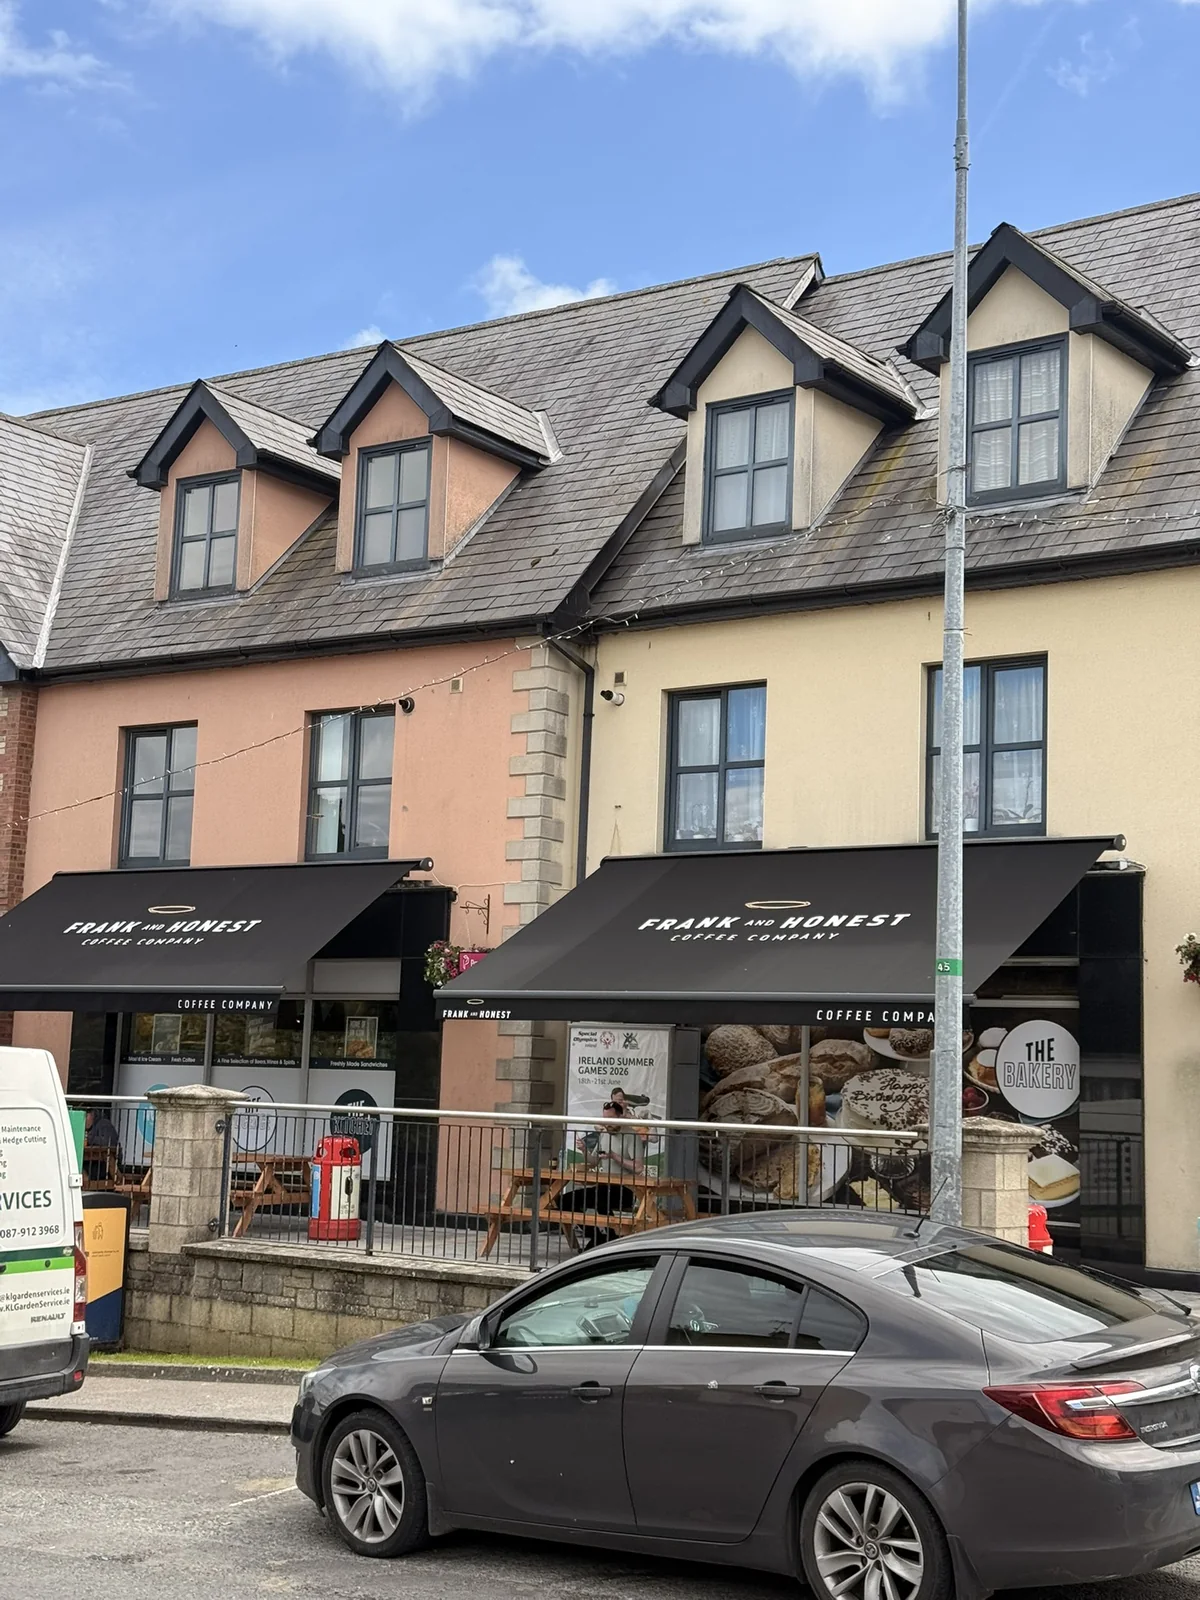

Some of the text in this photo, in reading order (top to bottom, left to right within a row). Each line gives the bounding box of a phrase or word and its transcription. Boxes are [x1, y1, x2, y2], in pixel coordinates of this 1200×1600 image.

[63, 921, 142, 934] FRANK
[165, 920, 262, 933] HONEST
[638, 913, 911, 931] FRANK AND HONEST
[81, 937, 204, 946] COFFEE COMPANY
[670, 932, 840, 942] COFFEE COMPANY
[937, 961, 951, 972] 45
[177, 999, 273, 1010] COFFEE COMPANY
[442, 1009, 469, 1018] FRANK
[479, 1010, 512, 1019] HONEST
[816, 1010, 935, 1023] COFFEE COMPA
[1025, 1037, 1055, 1062] THE
[578, 1056, 655, 1067] IRELAND SUMMER
[578, 1066, 629, 1076] GAMES 2026
[1003, 1061, 1077, 1090] BAKERY
[1, 1125, 41, 1133] Maintenance
[2, 1135, 47, 1145] Hedge Cutting
[0, 1190, 52, 1210] VICES
[0, 1224, 60, 1239] 087-912 3968
[30, 1313, 66, 1323] RENAULT
